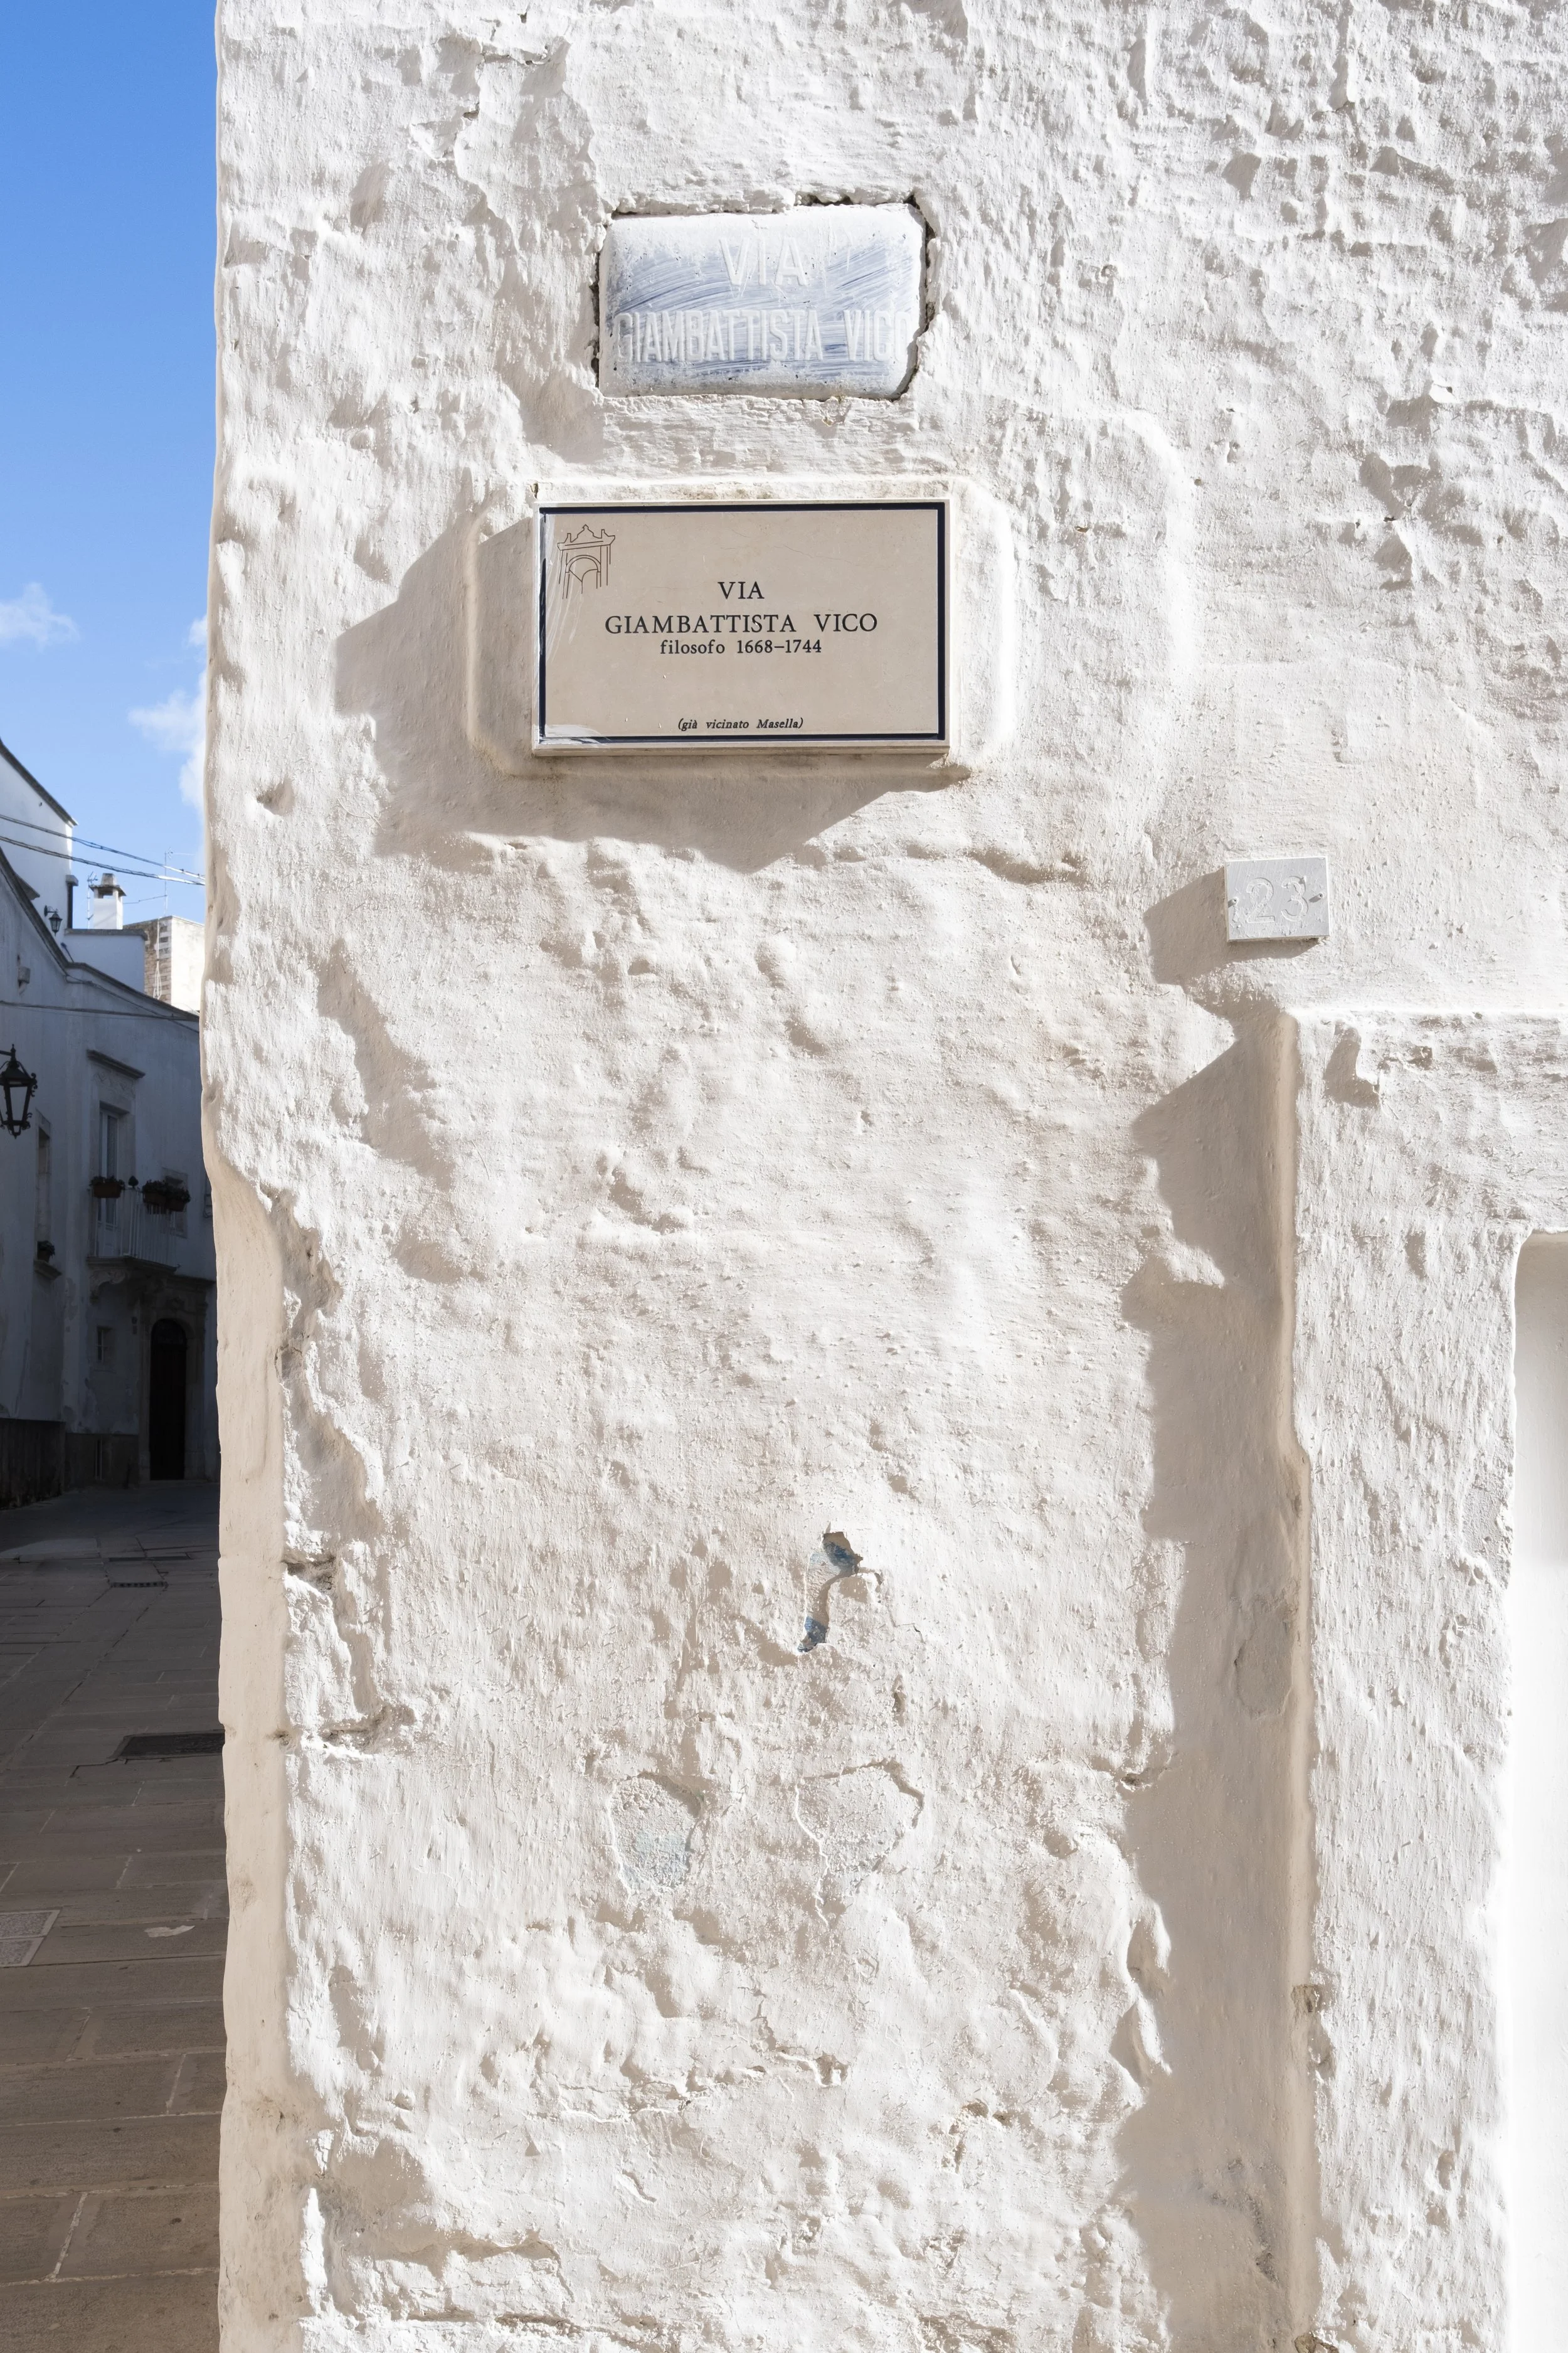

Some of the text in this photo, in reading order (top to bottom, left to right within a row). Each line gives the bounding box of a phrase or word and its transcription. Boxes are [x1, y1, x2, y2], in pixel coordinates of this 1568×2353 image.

[719, 236, 808, 287] VIA
[614, 309, 823, 363] GIAMBATTISTA
[718, 582, 765, 600] VIA
[605, 612, 878, 634] GIAMBATTISTA VICO
[660, 639, 726, 655] filosofo
[677, 717, 803, 732] (già vicinato Masella)
[1246, 876, 1309, 923] 23
